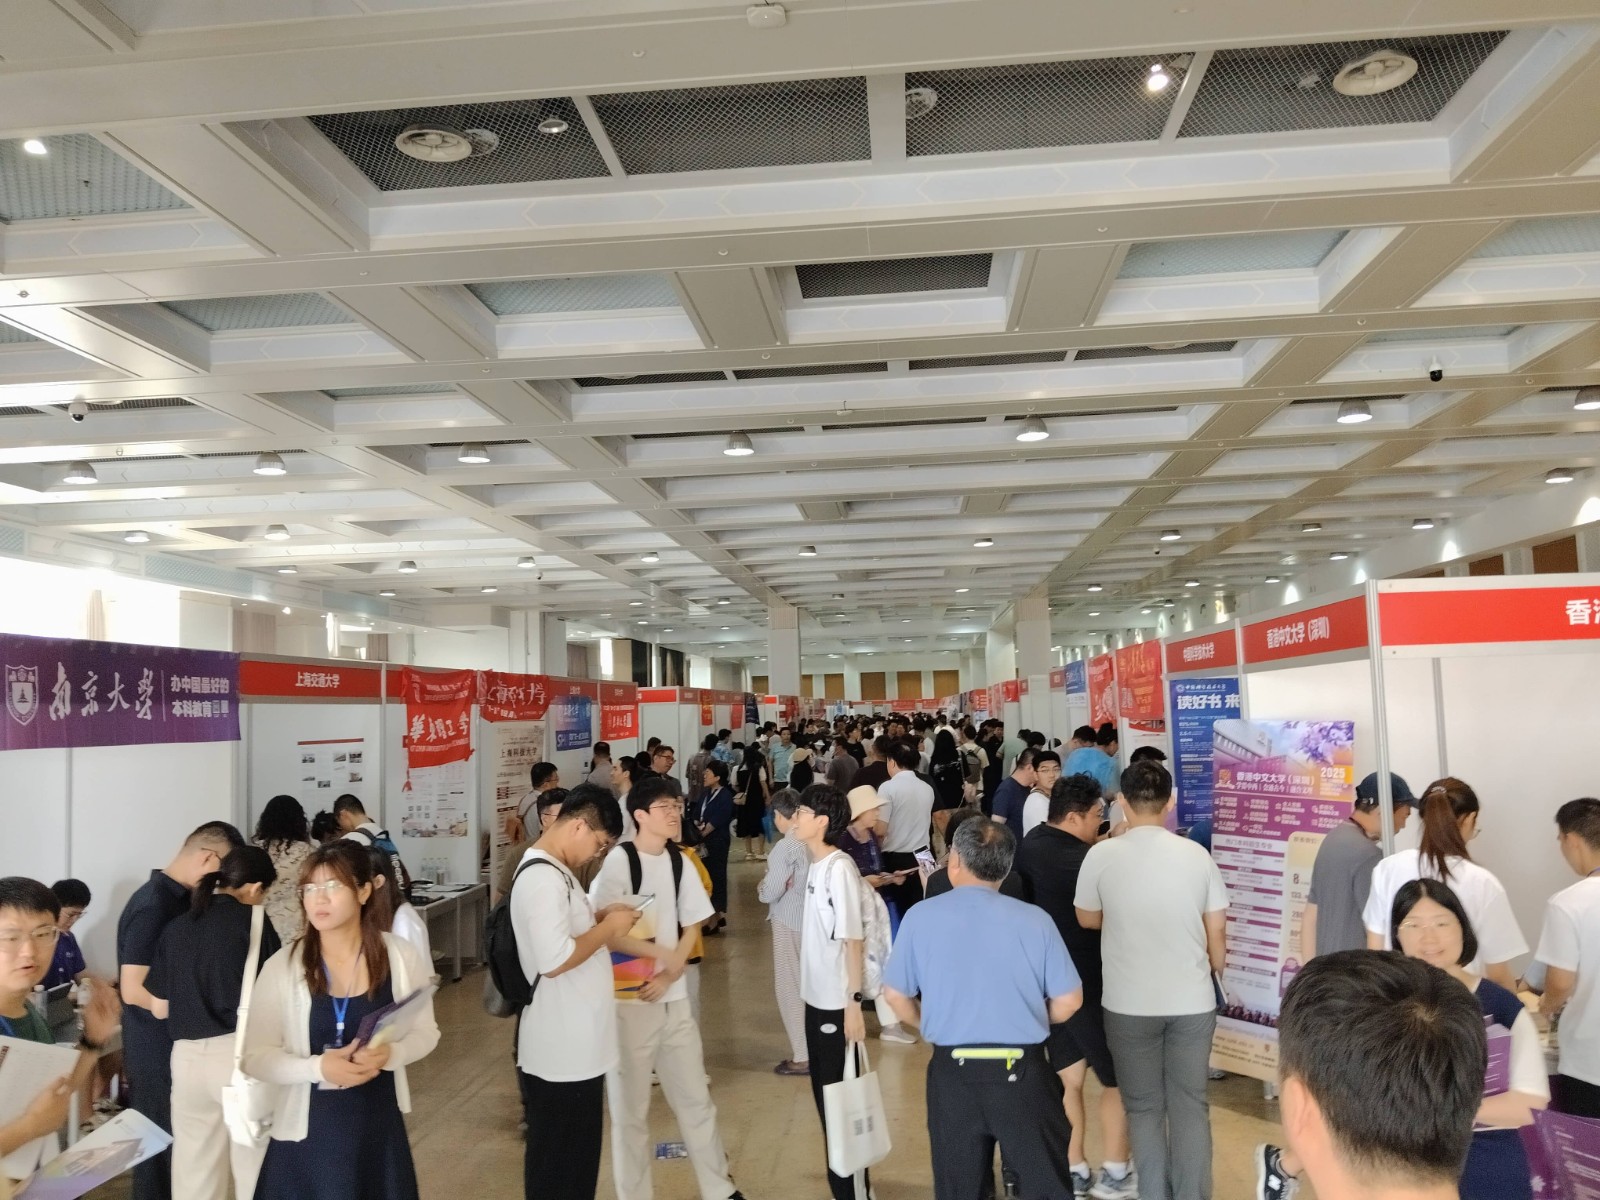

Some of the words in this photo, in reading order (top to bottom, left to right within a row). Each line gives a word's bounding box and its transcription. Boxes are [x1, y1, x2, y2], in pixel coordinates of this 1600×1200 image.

[171, 675, 229, 694] 办中国最好的
[295, 671, 340, 688] 上海交通大学
[172, 700, 212, 718] 本科教育
[1176, 693, 1222, 710] 读好书
[1320, 766, 1346, 779] 2025
